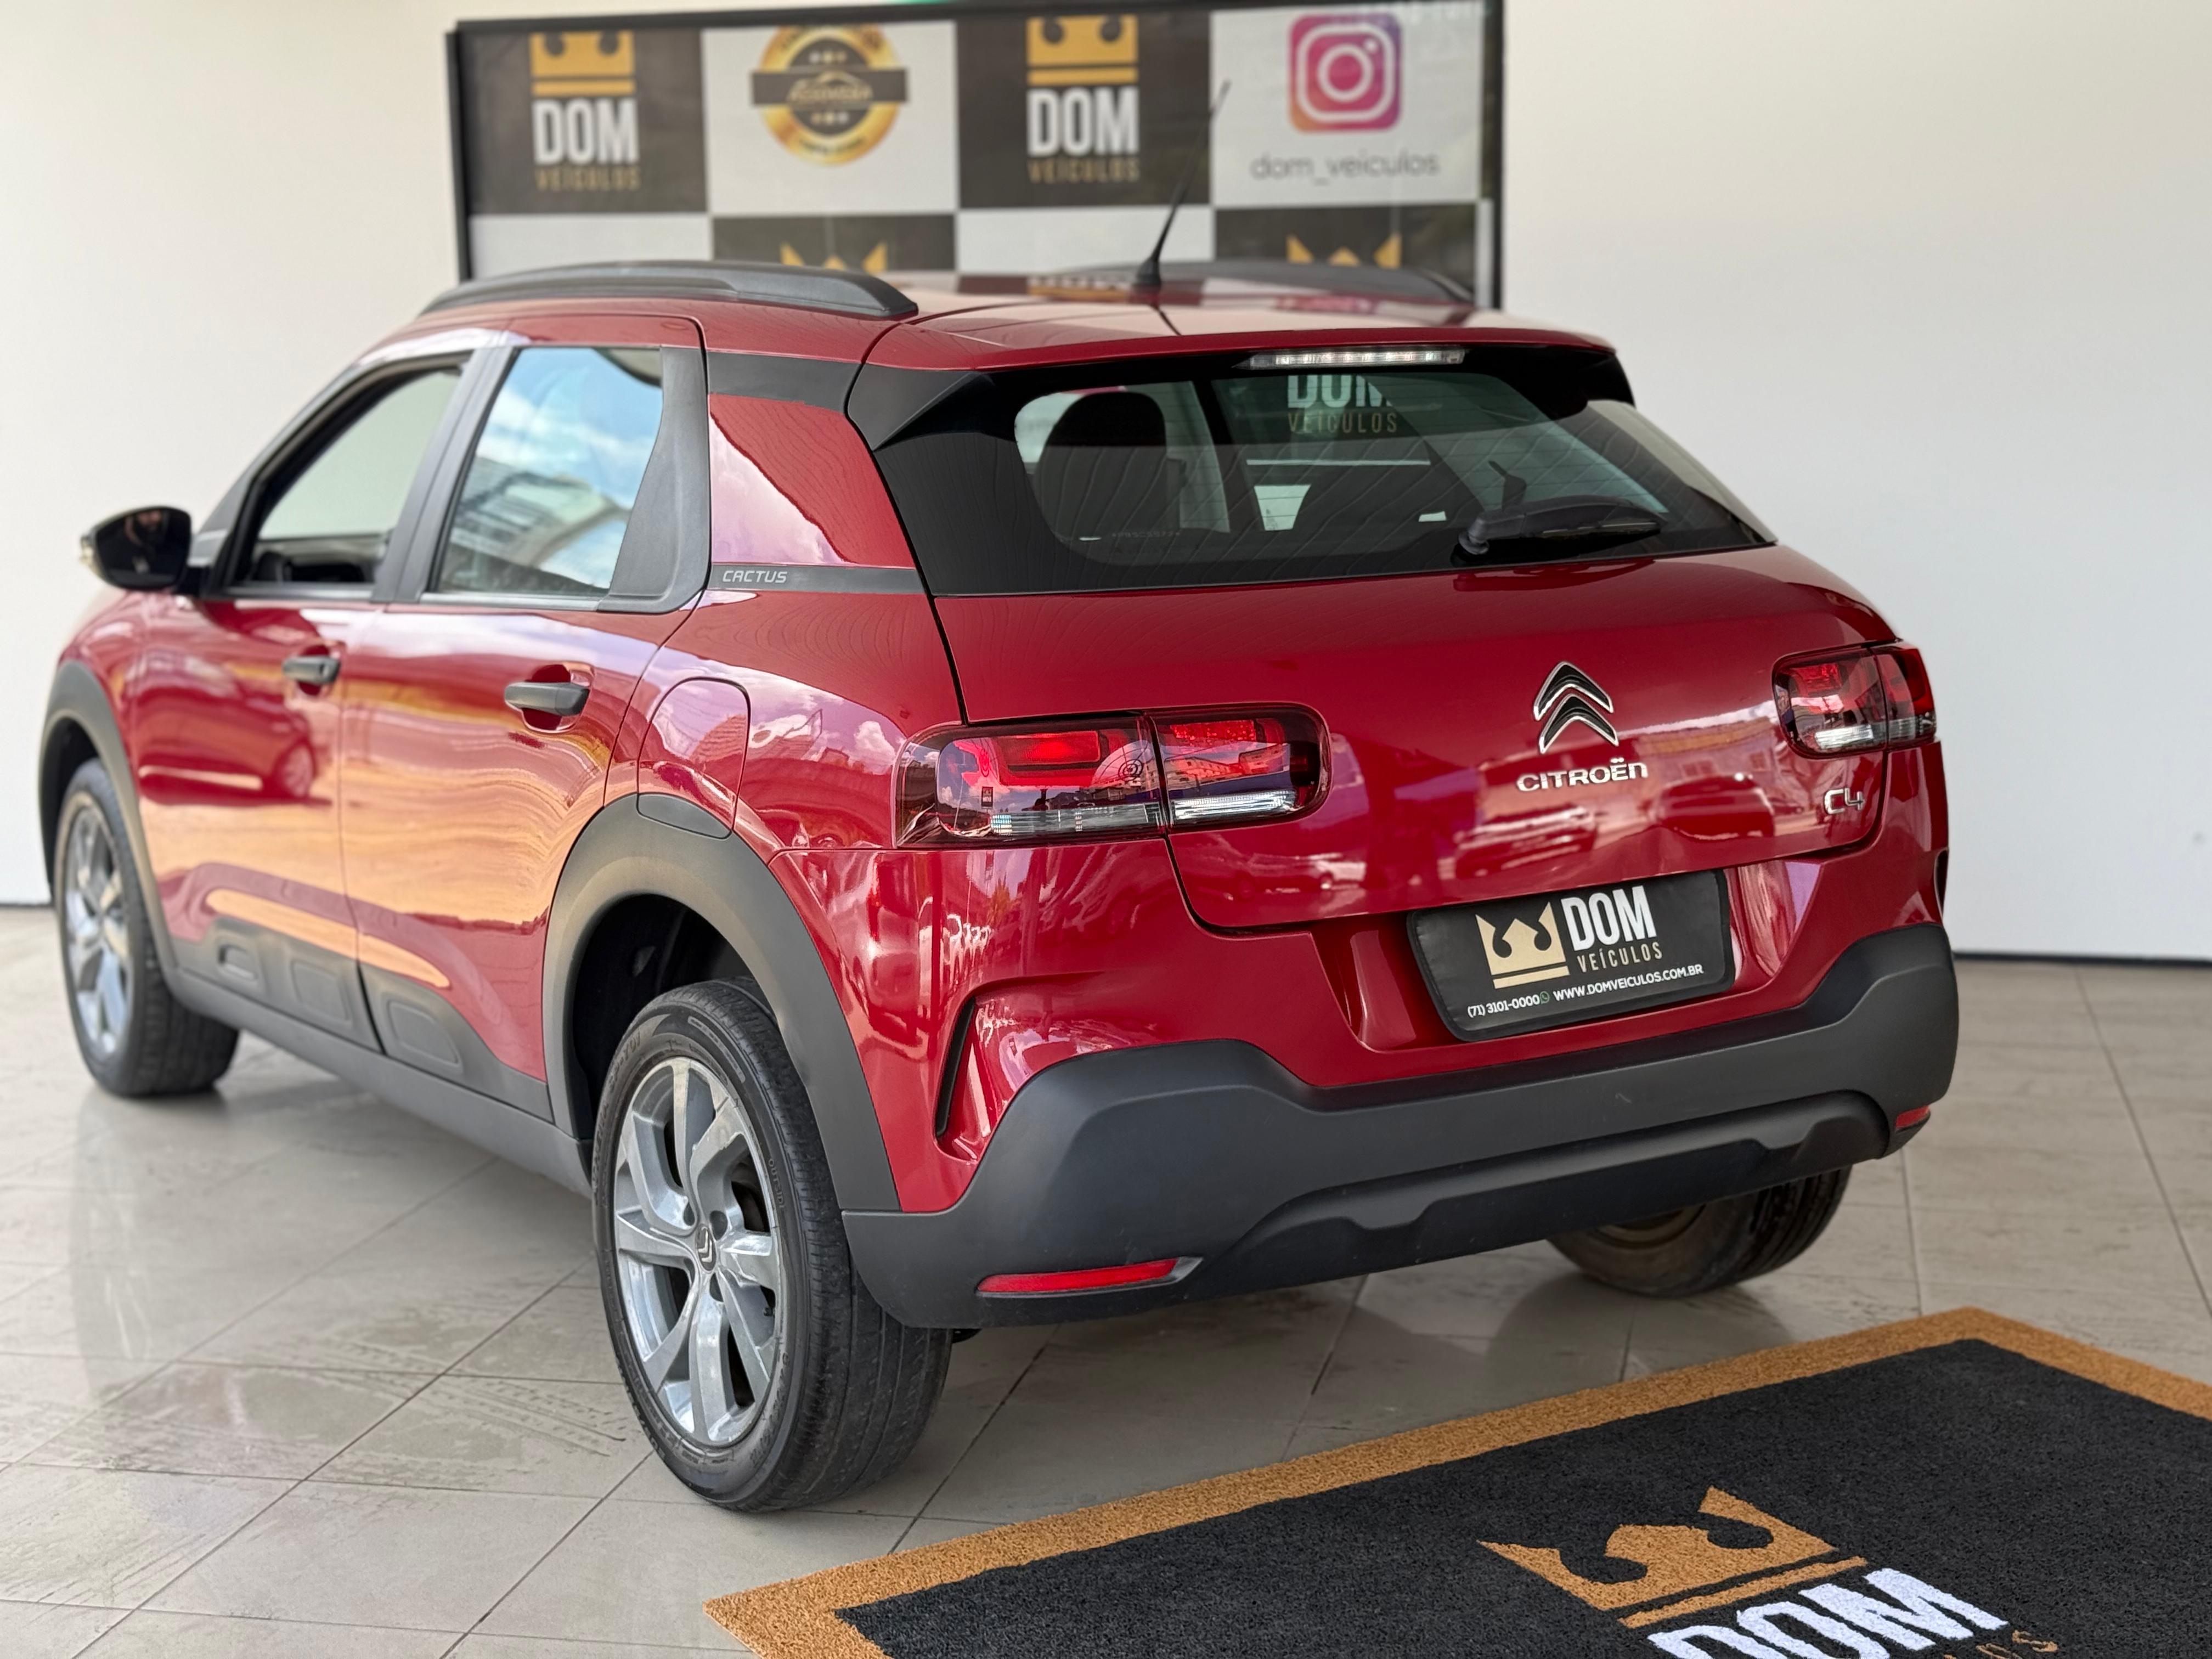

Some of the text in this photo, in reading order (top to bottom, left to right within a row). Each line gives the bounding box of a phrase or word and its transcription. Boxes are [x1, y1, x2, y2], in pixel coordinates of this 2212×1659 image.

[532, 98, 640, 164] DOM
[1026, 86, 1139, 157] DOM
[1249, 149, 1442, 186] dom_veiculos
[723, 570, 788, 583] CACTUS
[1824, 788, 1865, 815] C4
[1561, 885, 1657, 951] DOM
[1577, 941, 1663, 973] VEÍCULOS
[1467, 964, 1704, 1018] (71) 3101-0000 WWW.DOMVEICULOS.COM.BR
